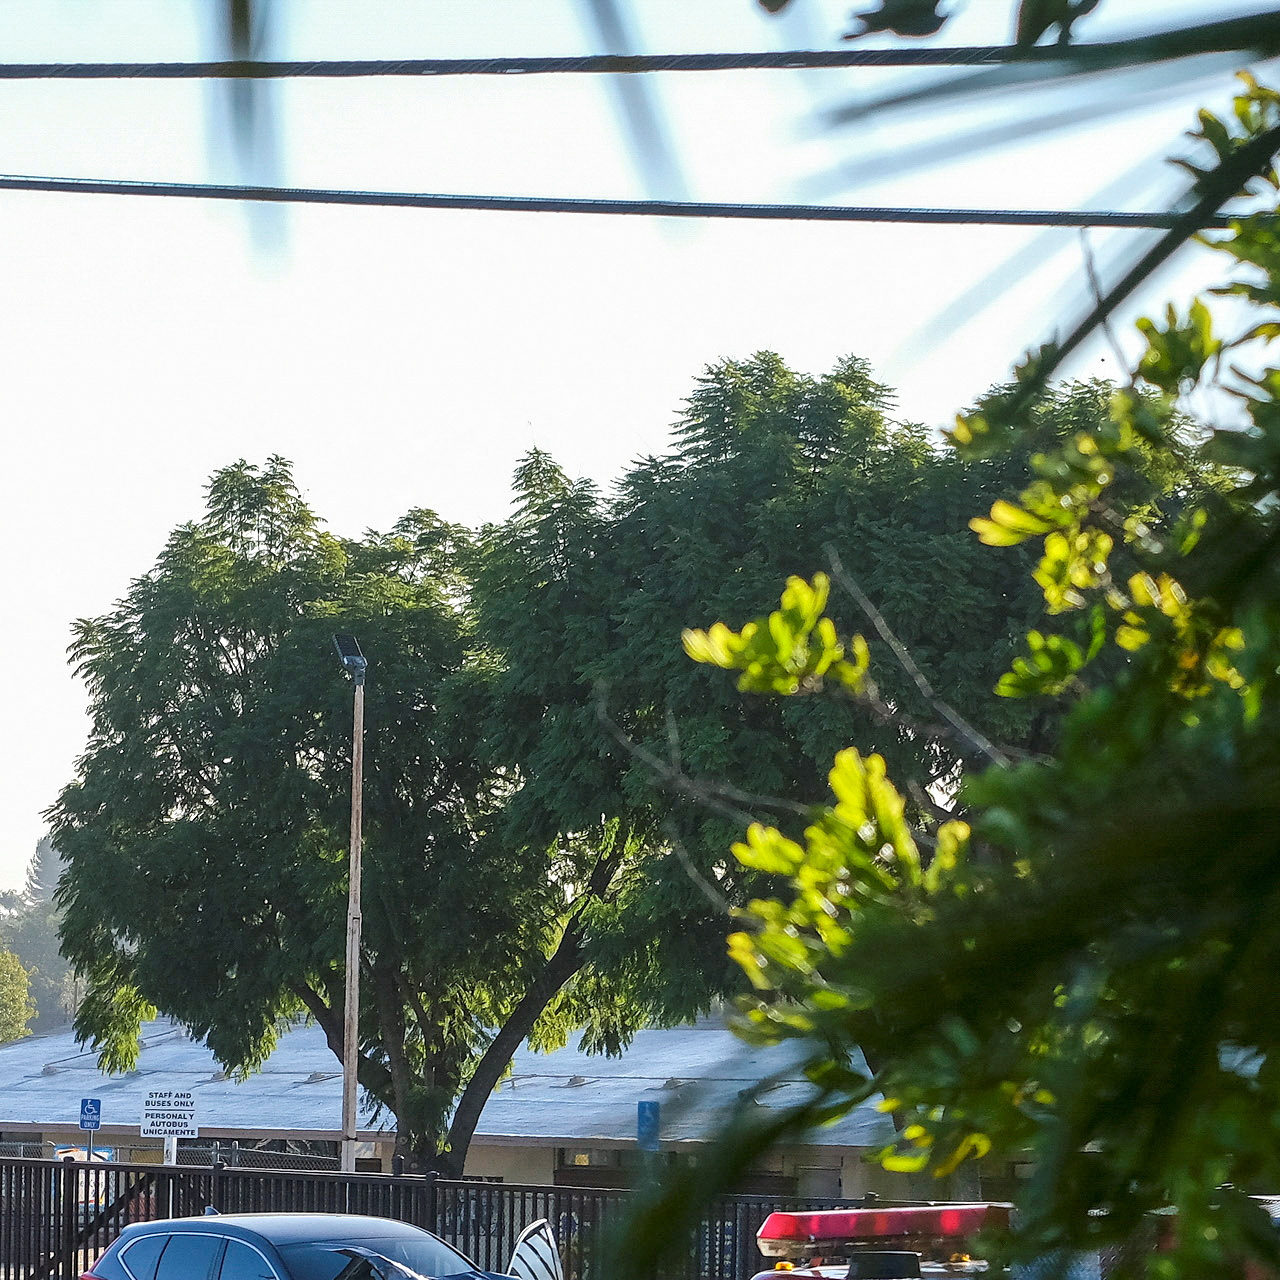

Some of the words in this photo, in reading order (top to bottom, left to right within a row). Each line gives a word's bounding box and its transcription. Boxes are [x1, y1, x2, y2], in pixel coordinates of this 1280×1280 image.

[80, 1113, 100, 1122] PARKING
[145, 1112, 187, 1120] PERSONAL
[143, 1128, 196, 1136] UNICAMENTE
